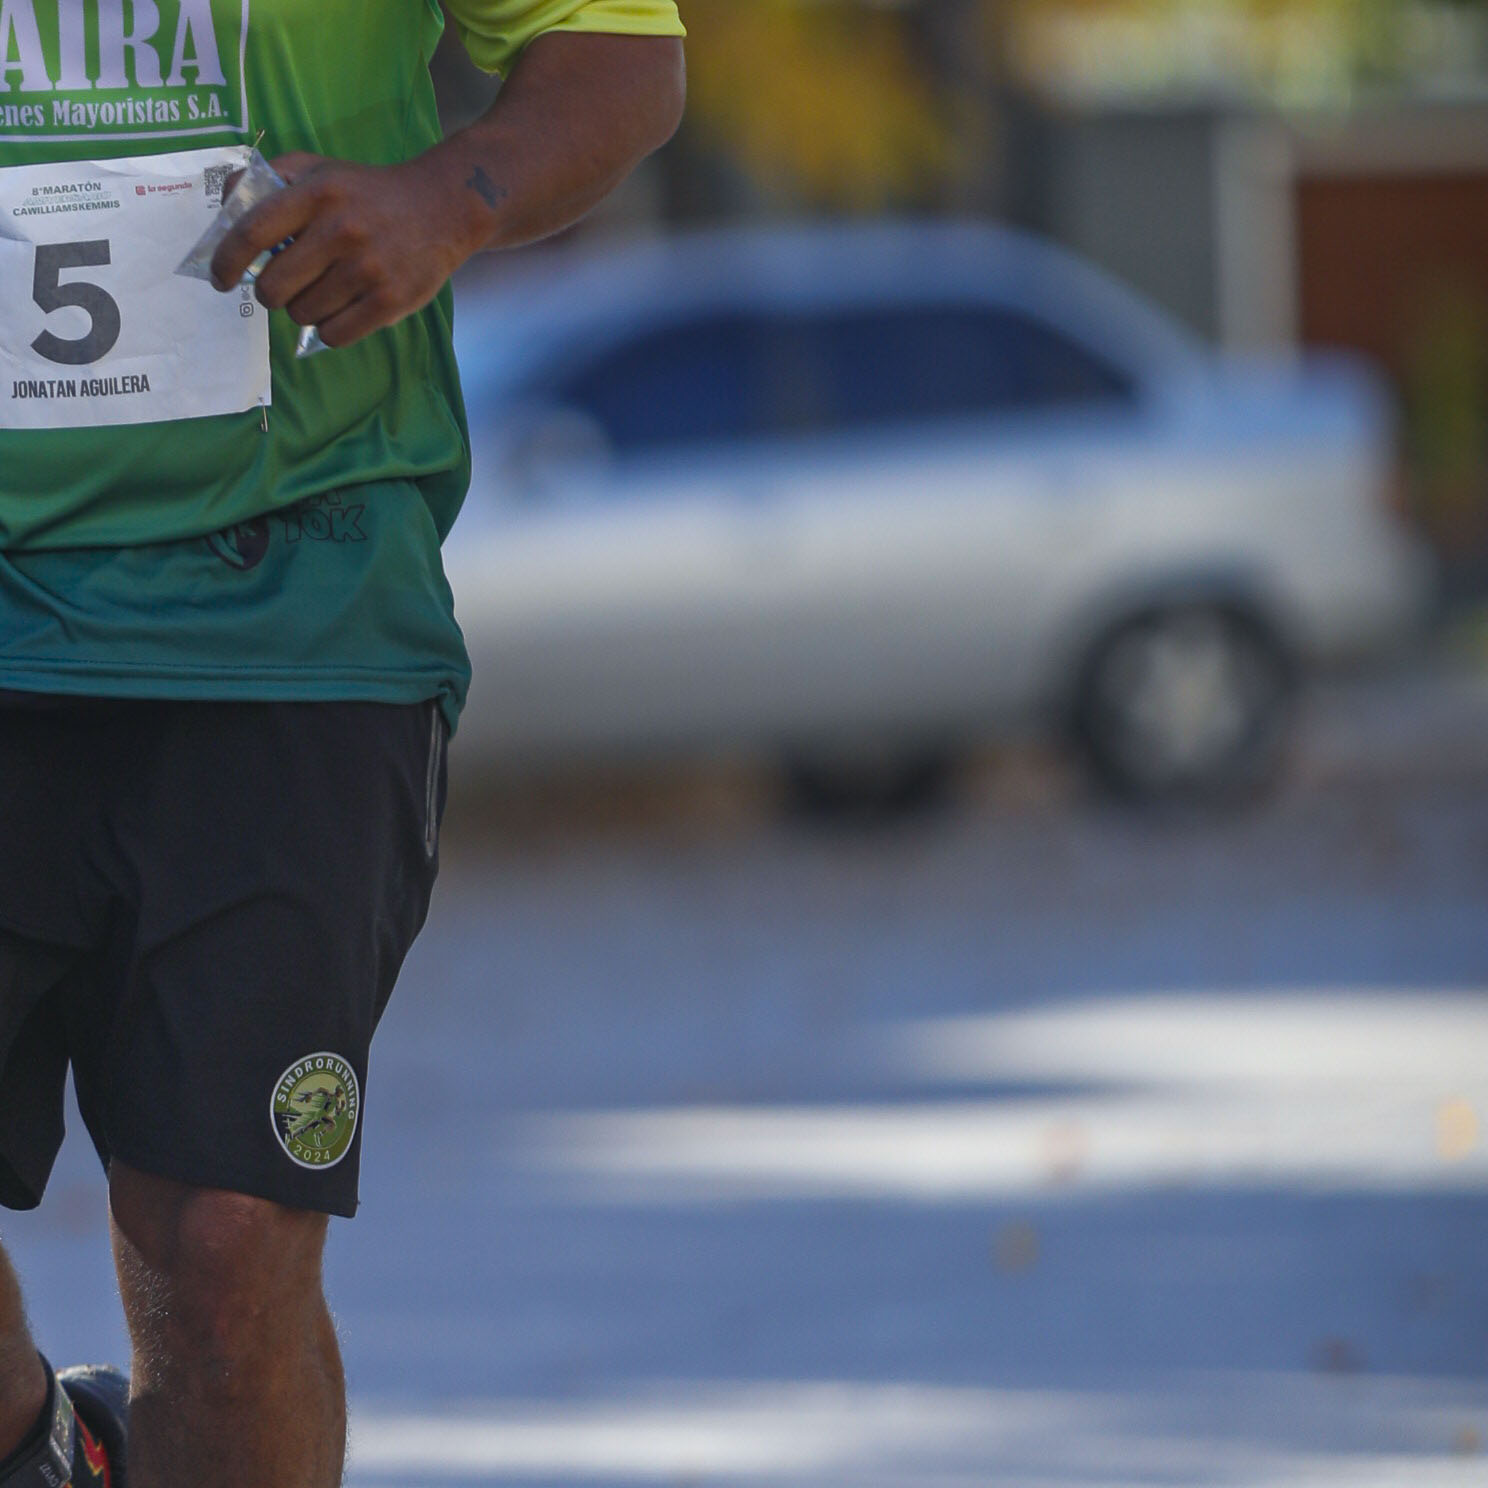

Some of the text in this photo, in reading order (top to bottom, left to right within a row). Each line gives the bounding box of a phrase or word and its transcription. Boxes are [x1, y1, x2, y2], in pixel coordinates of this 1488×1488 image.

[52, 96, 180, 130] Mayoristas
[187, 92, 228, 119] S.A.
[12, 199, 120, 216] CAWILLIAMSKEMMIS
[30, 238, 122, 365] 5
[11, 374, 151, 399] JONATAN AGUILERA
[277, 1058, 355, 1120] SINDRORUNNING
[294, 1144, 330, 1162] 2024
